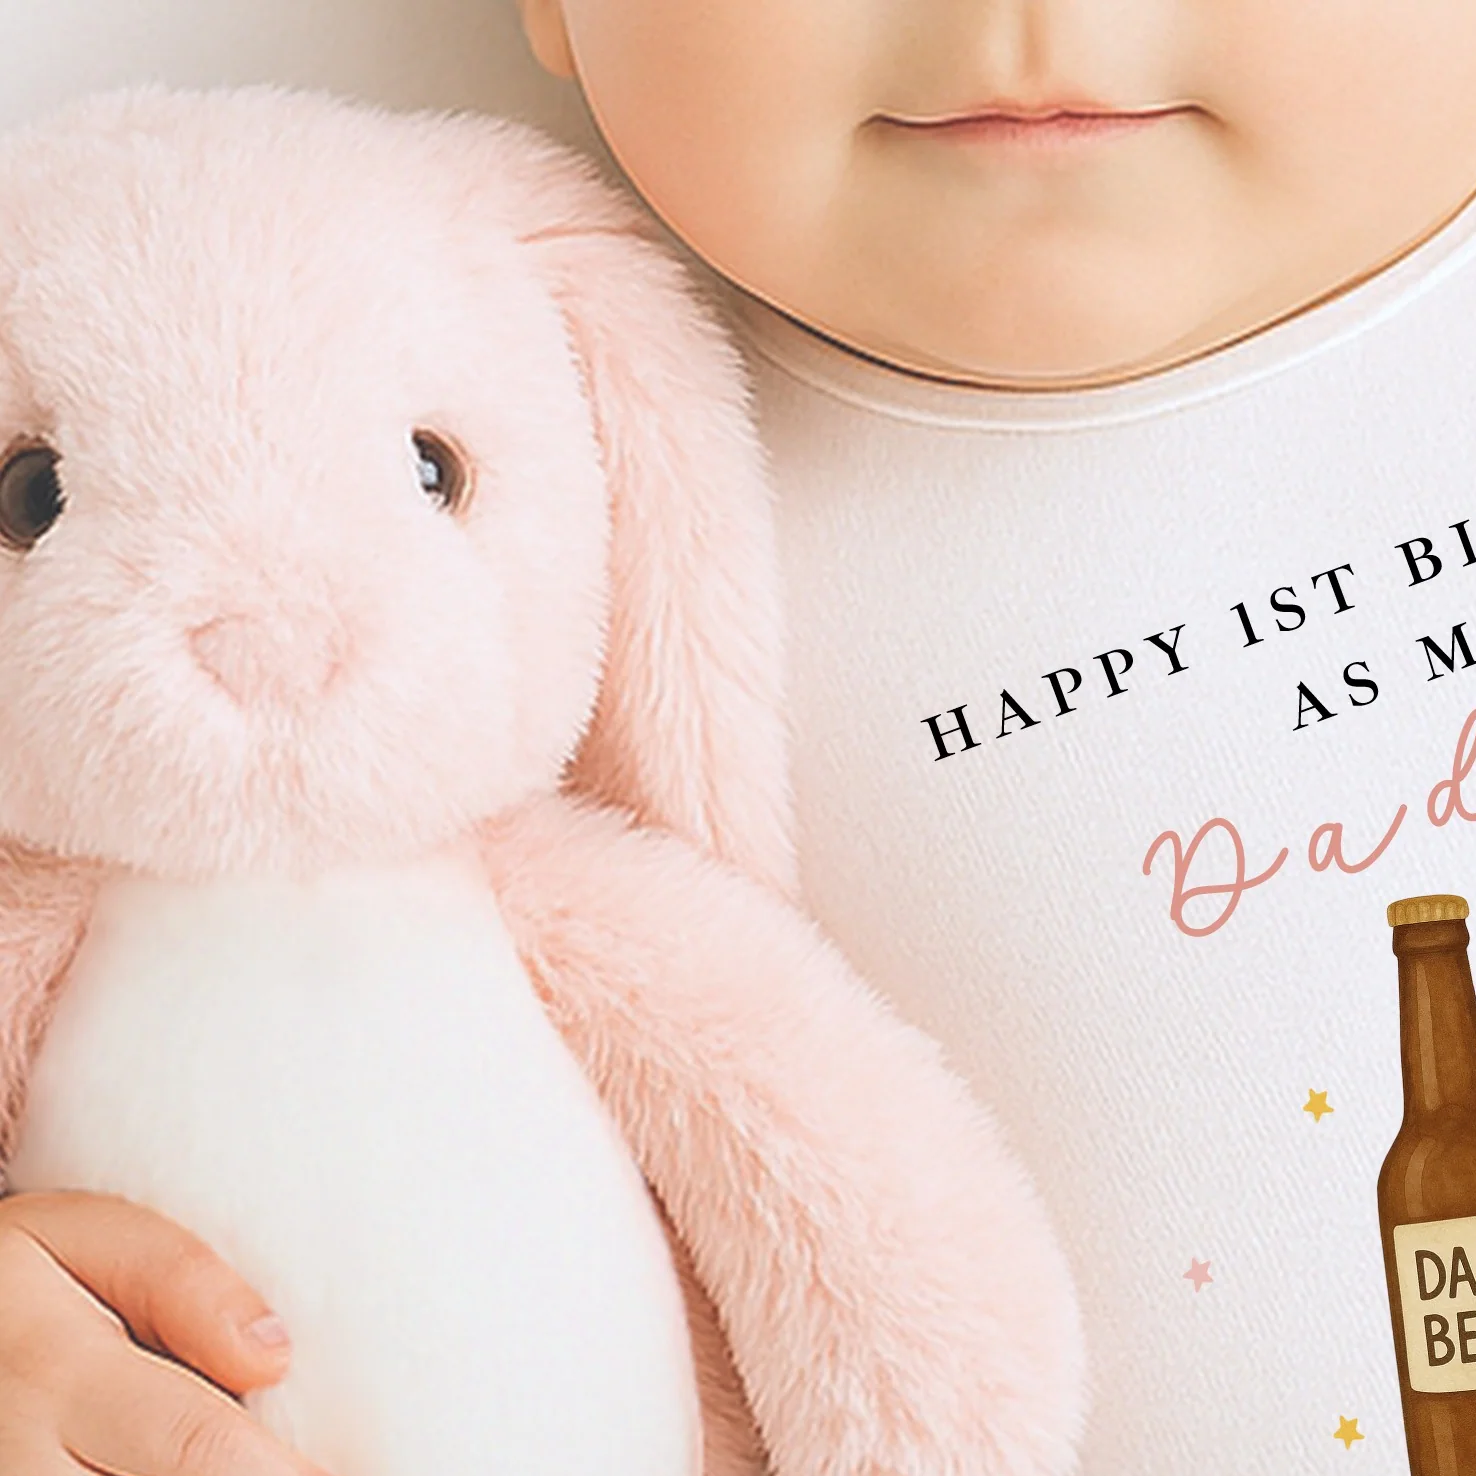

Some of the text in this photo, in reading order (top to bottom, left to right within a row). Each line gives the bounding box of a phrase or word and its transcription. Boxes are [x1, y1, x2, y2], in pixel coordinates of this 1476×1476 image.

[919, 624, 1190, 762] HAPPY
[1229, 563, 1356, 648] 1ST
[1292, 660, 1379, 732] AS
